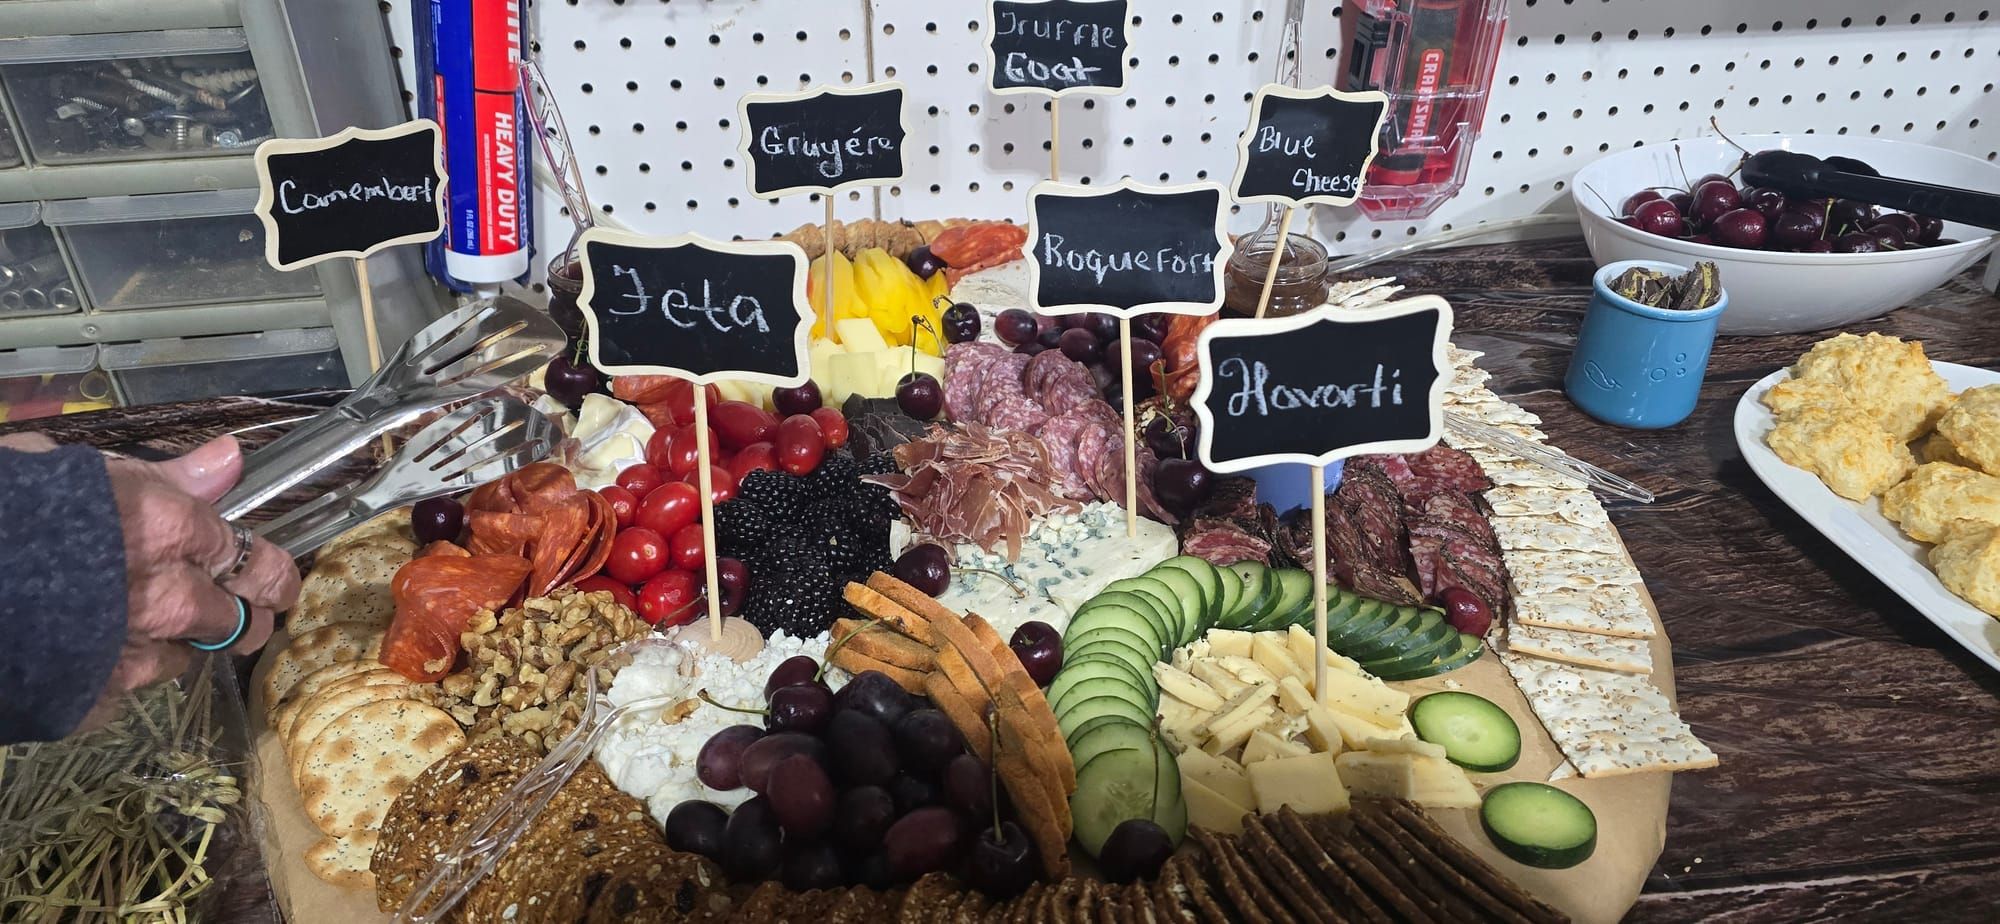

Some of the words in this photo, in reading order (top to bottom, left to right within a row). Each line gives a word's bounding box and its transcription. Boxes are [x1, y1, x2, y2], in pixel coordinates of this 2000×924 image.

[997, 12, 1117, 48] Truffle
[1005, 52, 1102, 82] Goat
[1408, 53, 1440, 150] CRAFTSMAN
[495, 112, 515, 184] HEAVY
[1260, 125, 1317, 159] Blue
[279, 176, 432, 214] Camembert
[1292, 168, 1363, 193] Cheese
[497, 188, 516, 247] DUTY
[608, 264, 770, 333] Feta
[1218, 357, 1402, 416] Havarti
